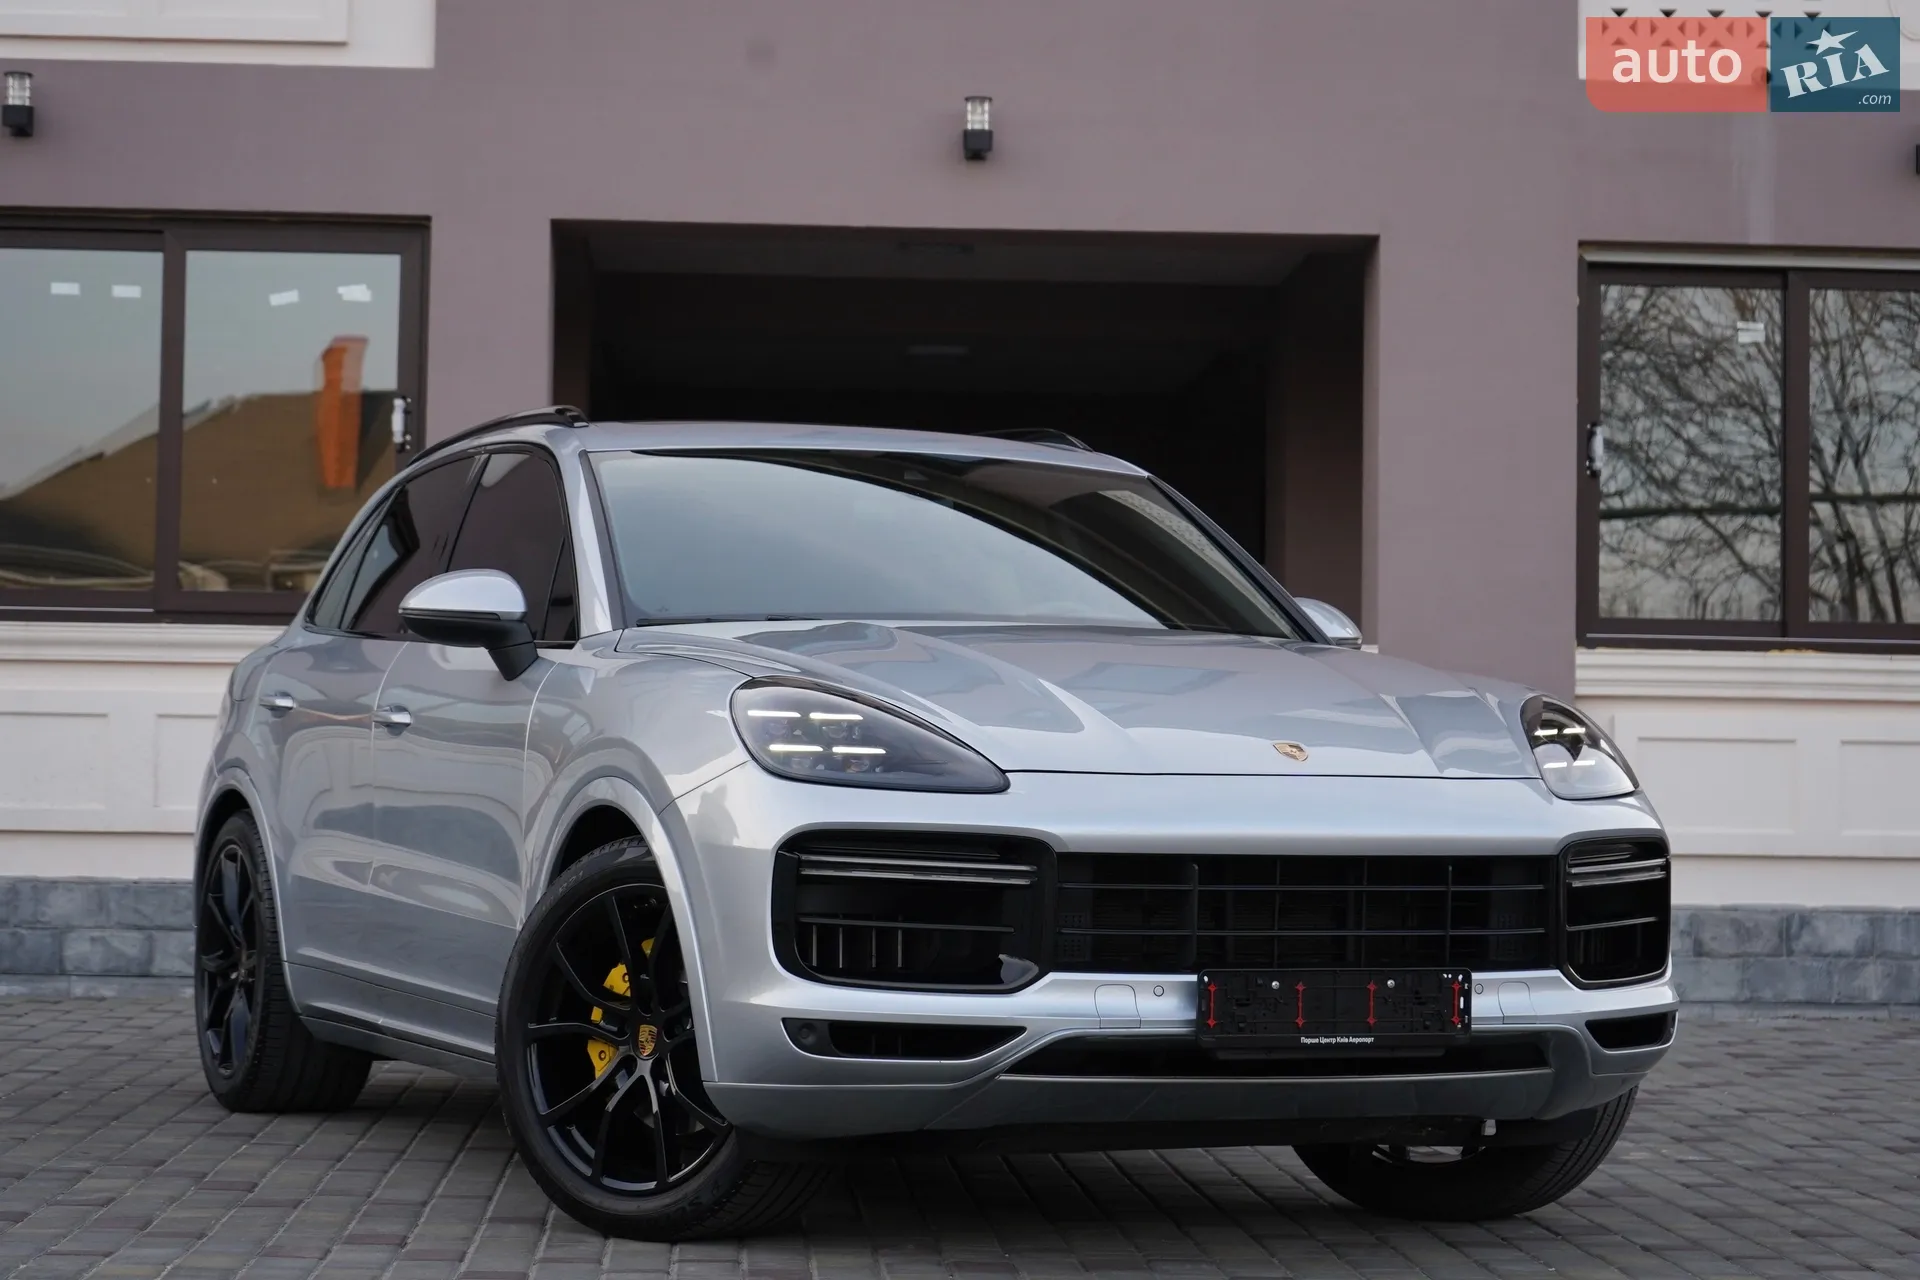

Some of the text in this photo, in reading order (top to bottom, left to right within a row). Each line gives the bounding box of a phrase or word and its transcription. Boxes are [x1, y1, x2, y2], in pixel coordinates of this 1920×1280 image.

[1300, 1036, 1320, 1045] Порше
[1320, 1036, 1336, 1045] Центр
[1349, 1036, 1375, 1045] Аеропорт
